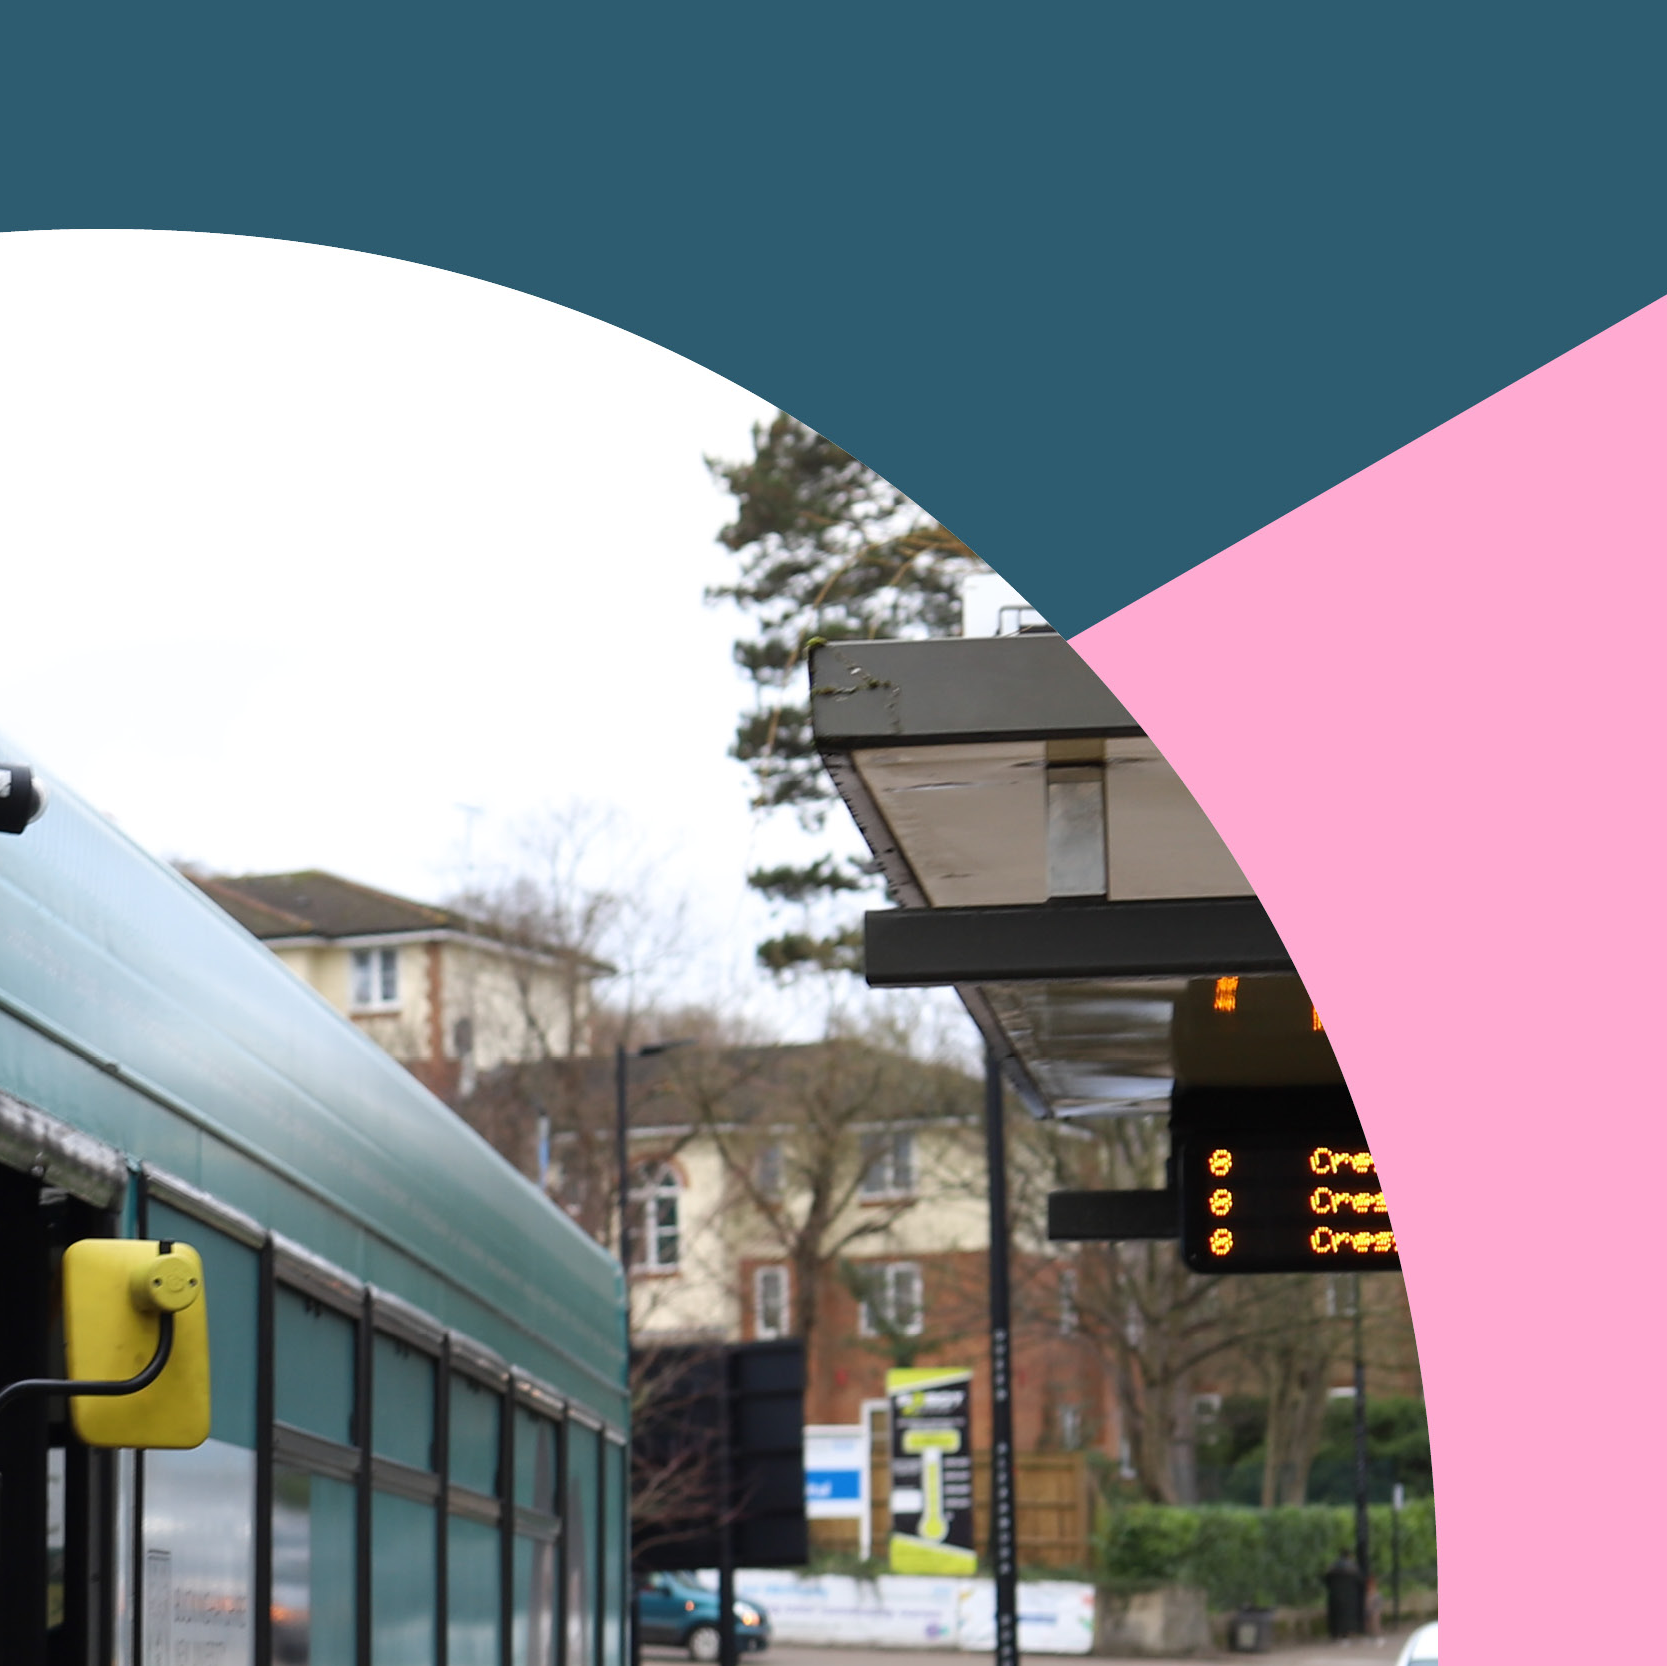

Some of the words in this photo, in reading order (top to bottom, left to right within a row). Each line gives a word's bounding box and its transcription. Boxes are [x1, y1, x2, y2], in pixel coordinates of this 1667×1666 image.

[1208, 1148, 1233, 1177] 8
[1309, 1146, 1377, 1175] Cre
[1208, 1188, 1233, 1216] 8
[1208, 1227, 1234, 1256] 8
[1309, 1226, 1400, 1254] Cres
